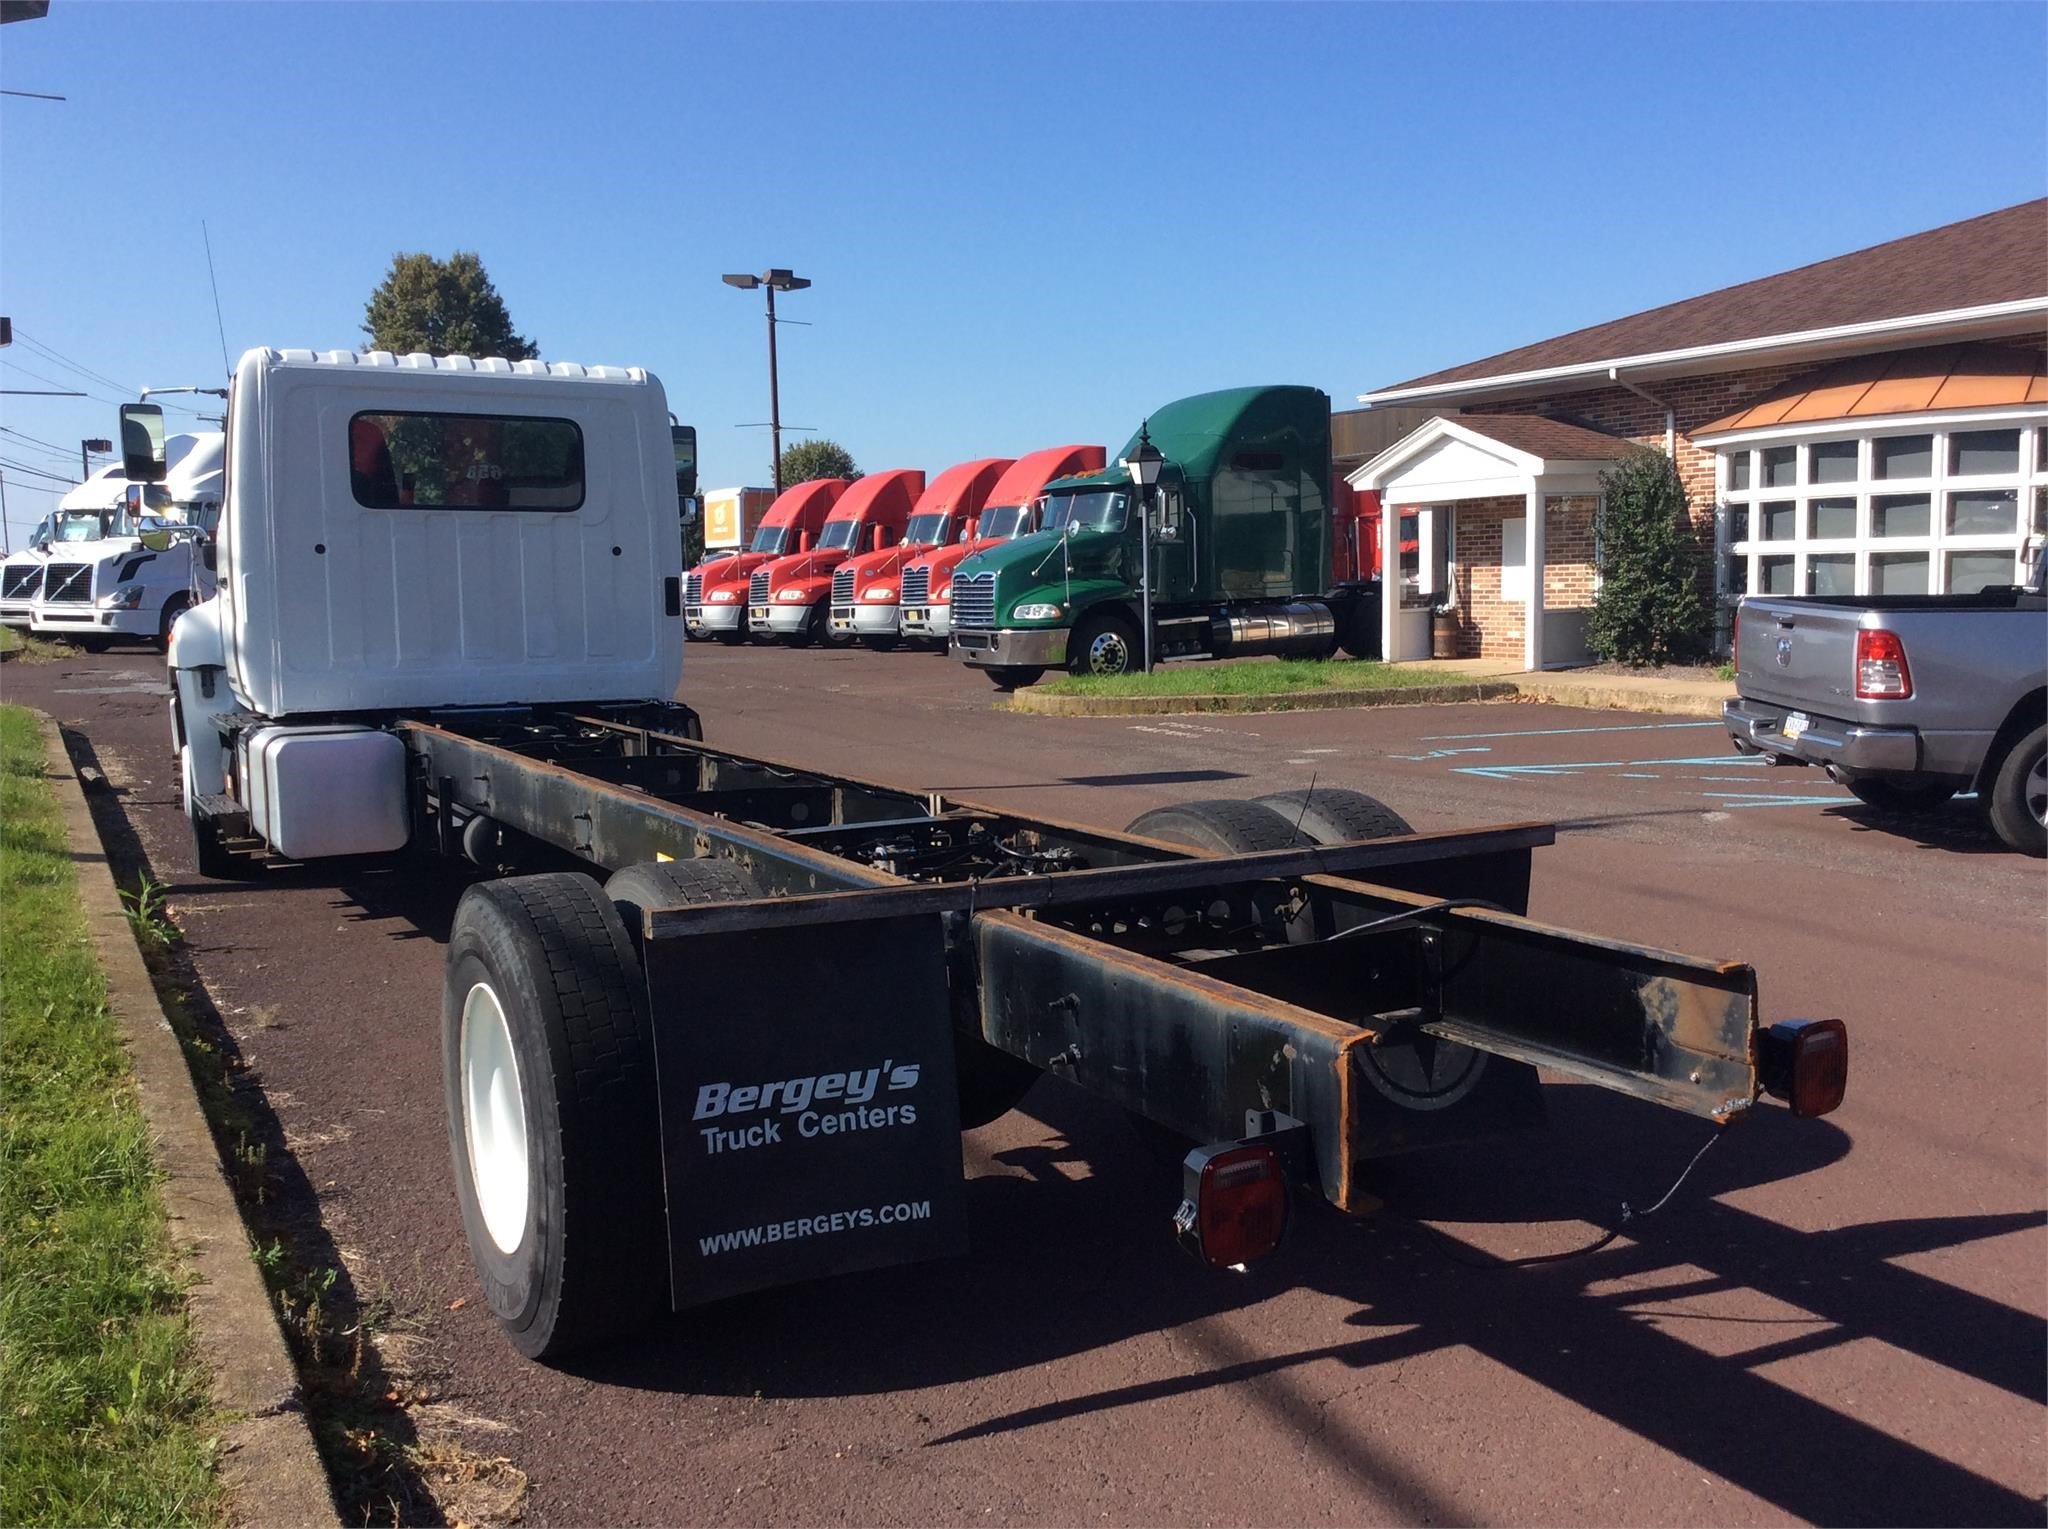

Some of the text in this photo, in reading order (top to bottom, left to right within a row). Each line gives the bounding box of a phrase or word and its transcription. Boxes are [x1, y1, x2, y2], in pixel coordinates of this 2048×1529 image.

[692, 1059, 920, 1120] Bergey's
[701, 1104, 917, 1154] Truck Centers
[699, 1201, 931, 1256] WWW.BERGEYS.COM
